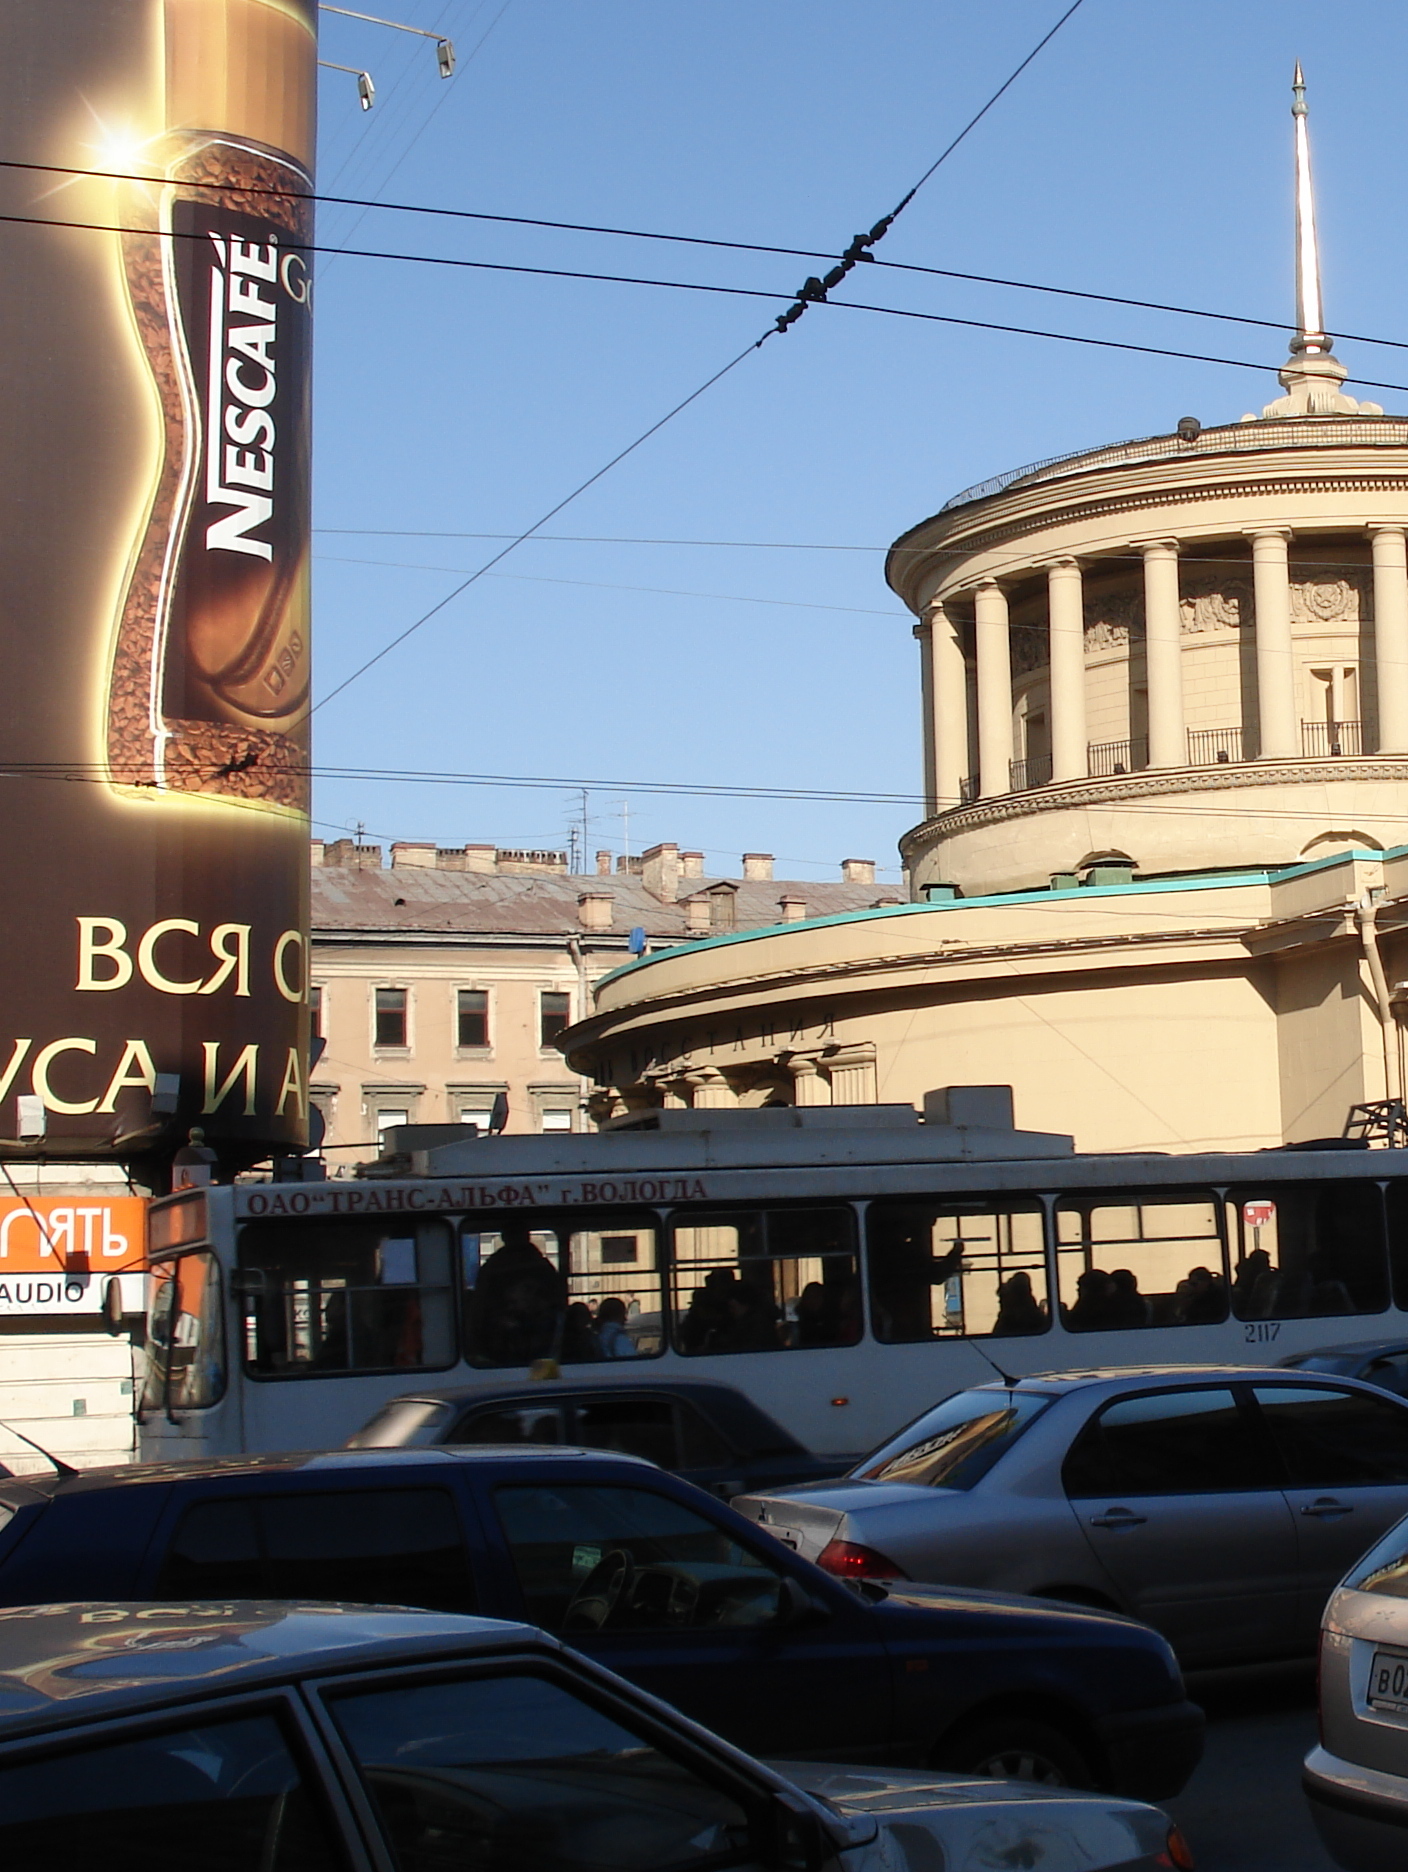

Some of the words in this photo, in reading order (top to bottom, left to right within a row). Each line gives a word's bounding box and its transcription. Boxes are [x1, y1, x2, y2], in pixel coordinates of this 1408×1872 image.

[75, 916, 252, 997] ВСЯ
[273, 929, 309, 1004] С
[201, 1041, 260, 1116] И
[274, 1046, 309, 1119] А
[0, 1282, 84, 1304] AUDIO
[1244, 1323, 1281, 1343] 2117
